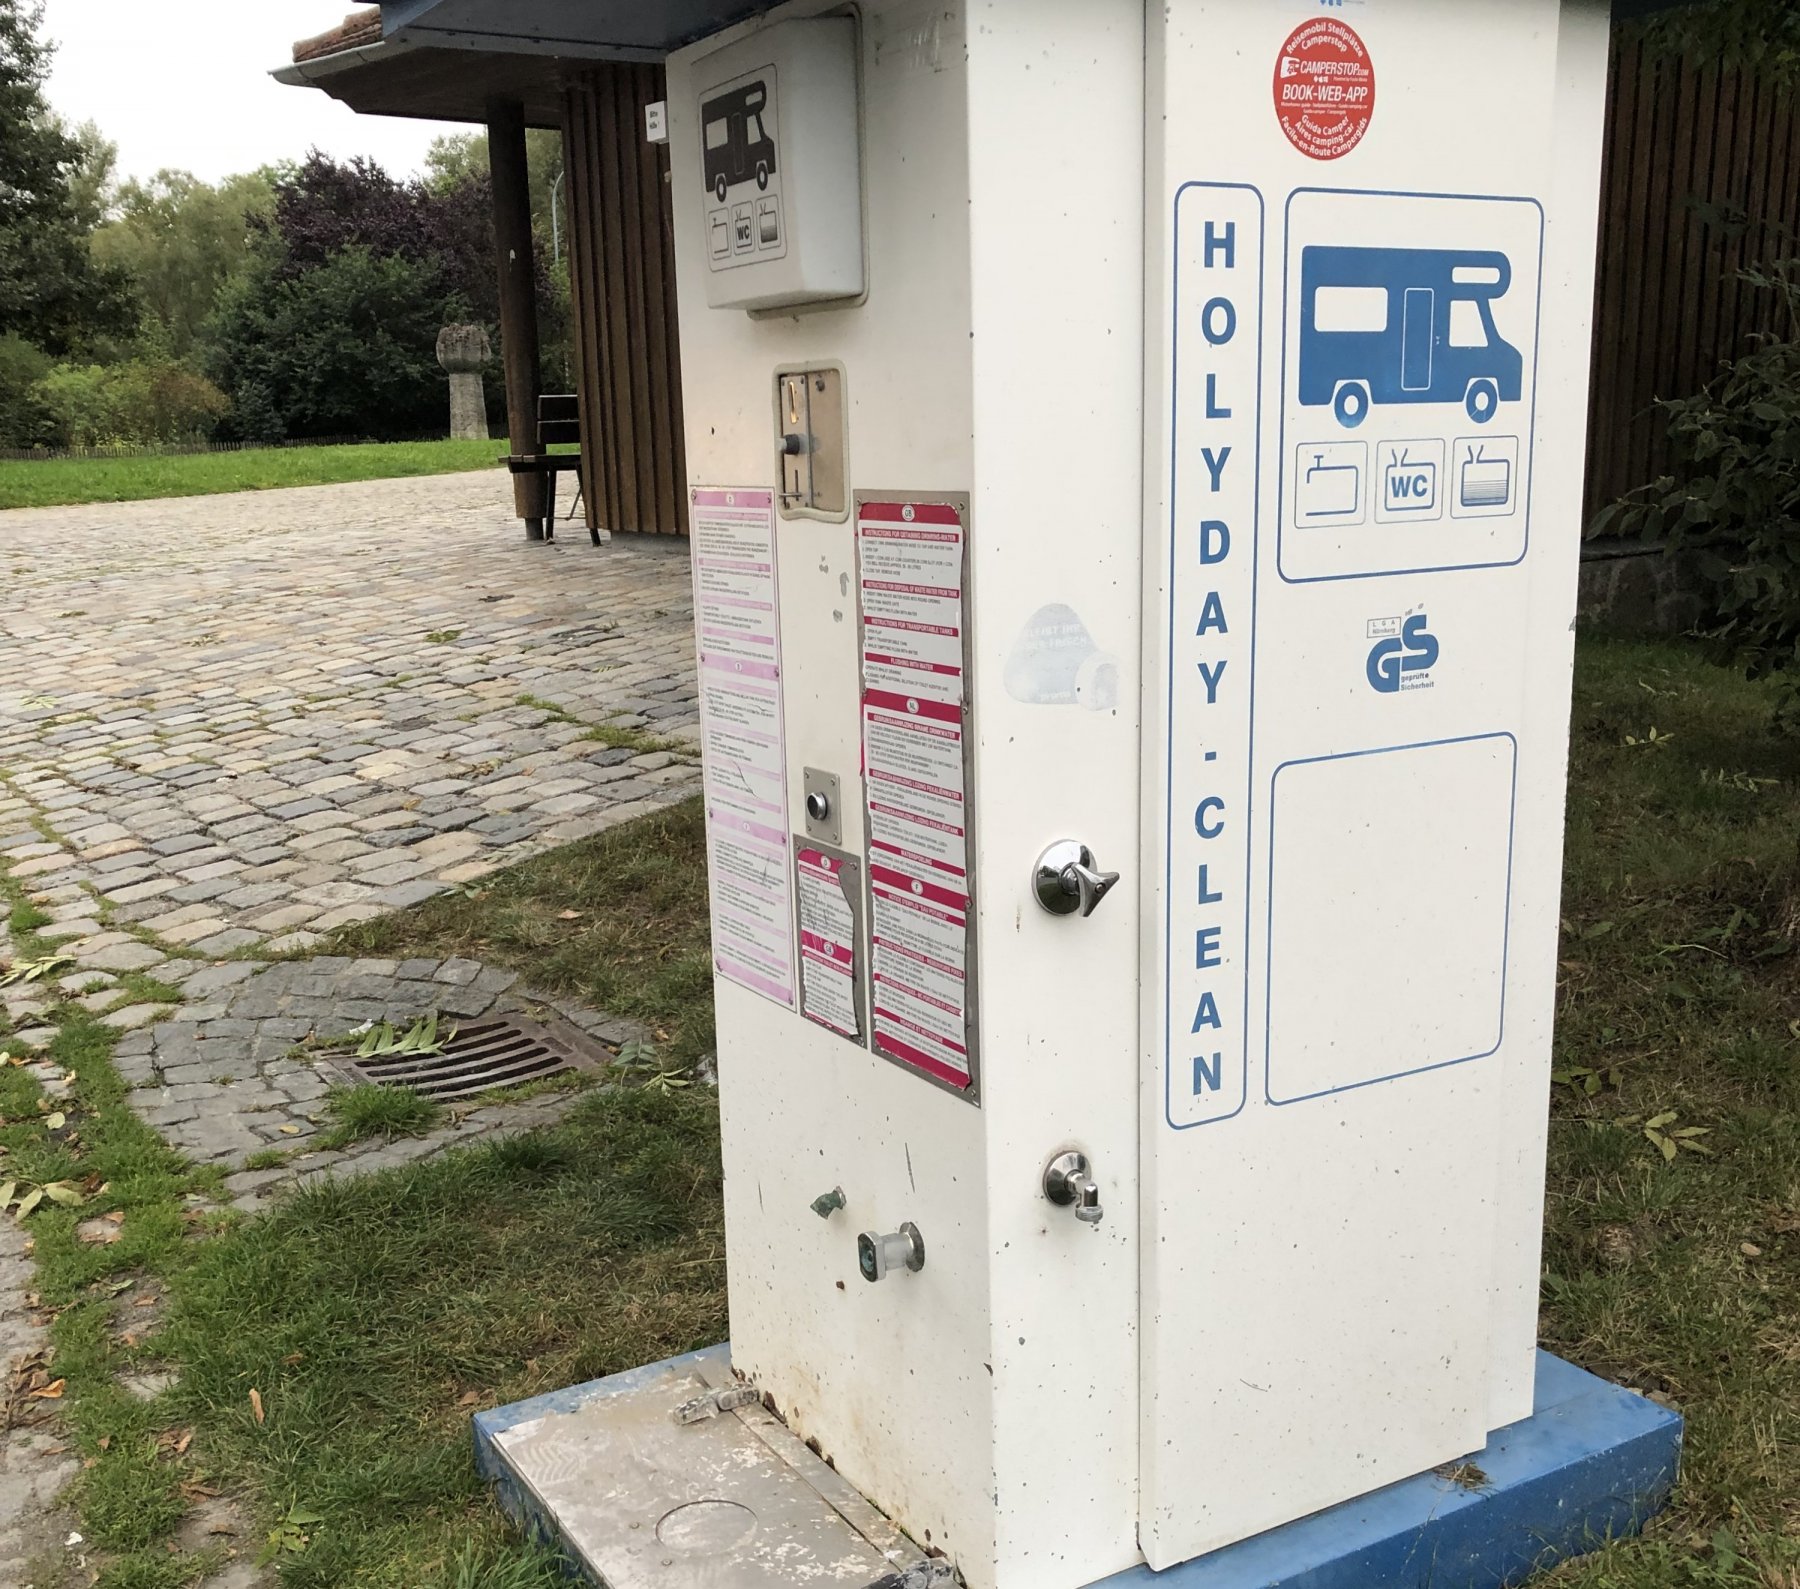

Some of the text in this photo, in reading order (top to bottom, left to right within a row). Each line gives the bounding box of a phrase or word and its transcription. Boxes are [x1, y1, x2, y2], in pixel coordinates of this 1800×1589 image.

[1286, 22, 1326, 54] Reisemobil
[1302, 35, 1347, 52] Camperstop
[1282, 84, 1368, 102] BOOK-WEB-APP
[1295, 121, 1354, 146] Aires camping-car
[1302, 115, 1349, 135] Guida Camper
[1332, 117, 1367, 154] Campergids
[737, 225, 749, 240] WC
[1391, 475, 1427, 498] WC
[1401, 681, 1434, 691] Sicherheit
